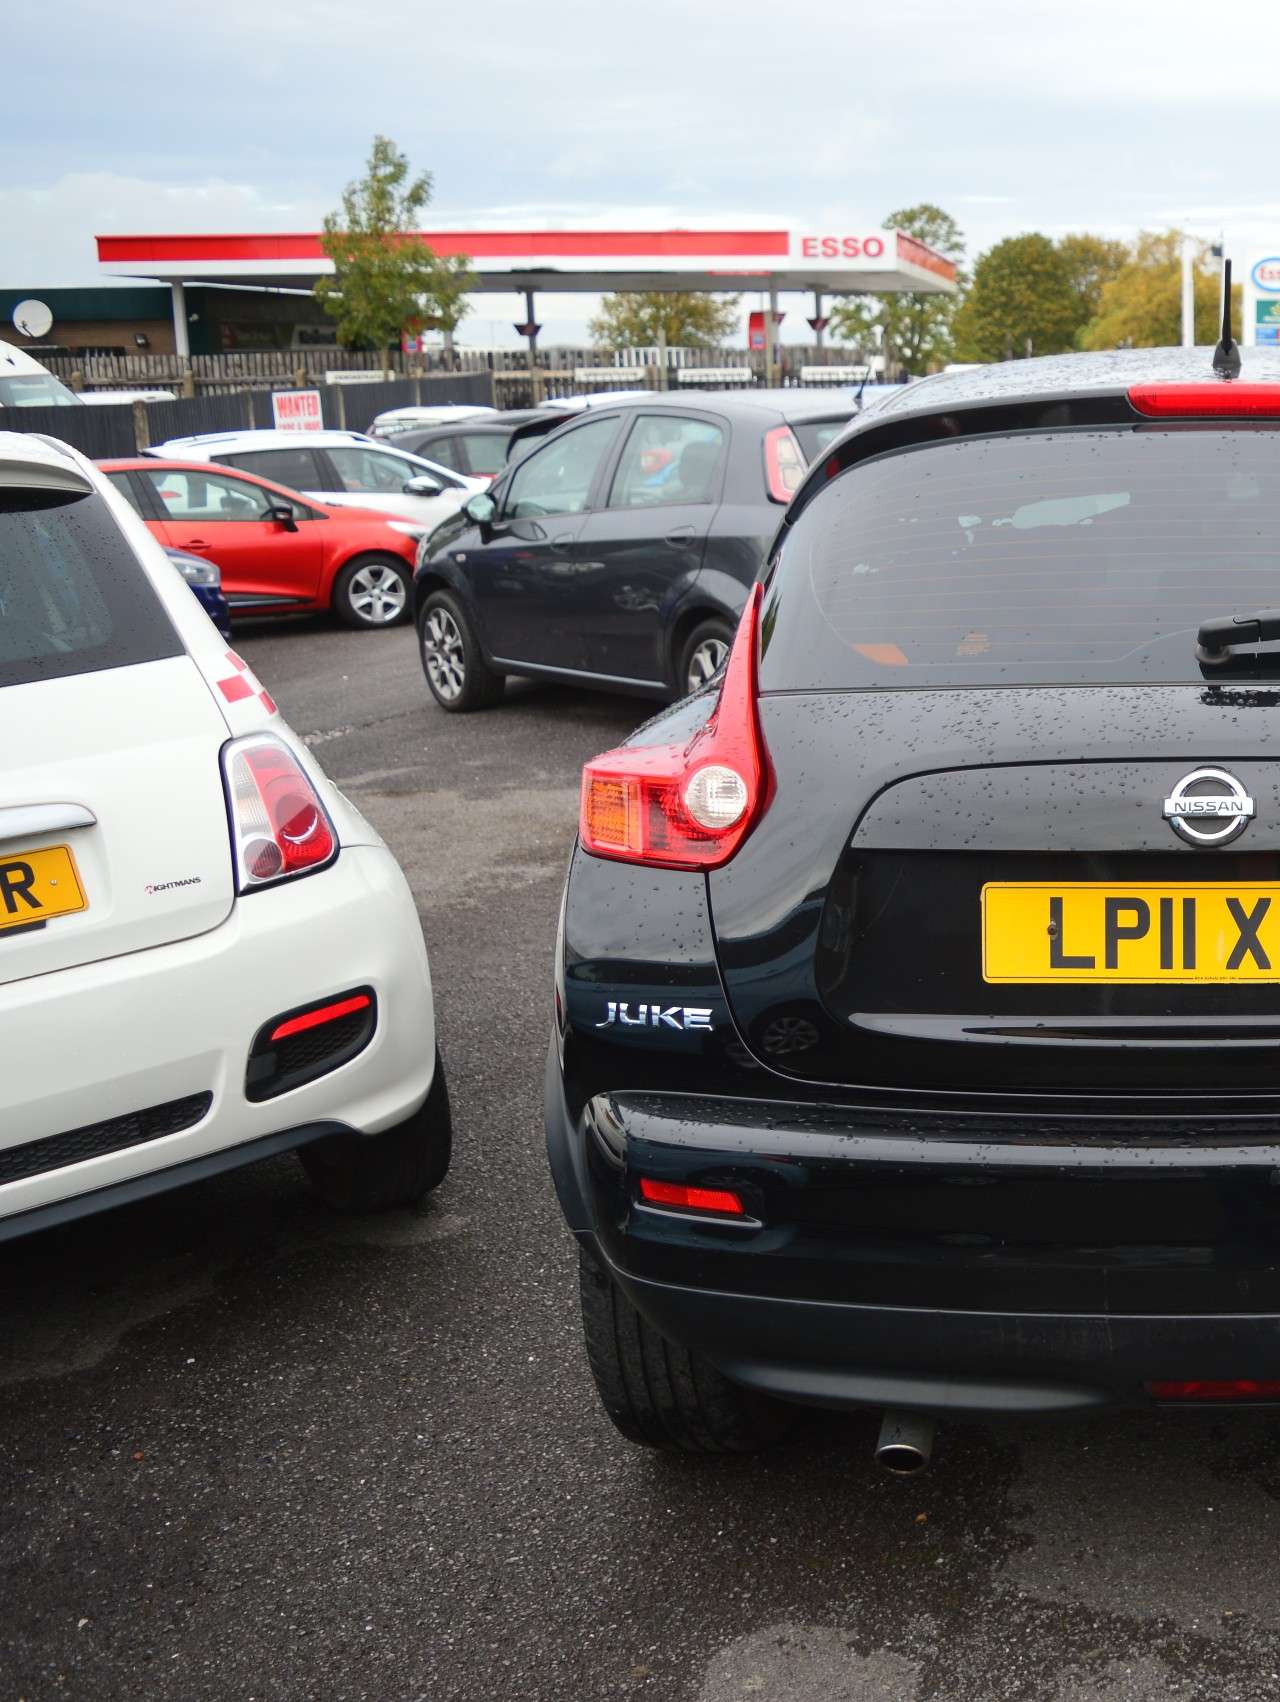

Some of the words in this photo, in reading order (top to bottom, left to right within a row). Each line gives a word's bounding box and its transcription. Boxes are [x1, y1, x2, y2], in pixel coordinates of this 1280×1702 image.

[801, 237, 885, 258] ESSO
[275, 394, 319, 417] WANTED
[1175, 801, 1243, 812] NISSAN
[0, 861, 43, 914] R
[595, 1002, 713, 1032] JUKE
